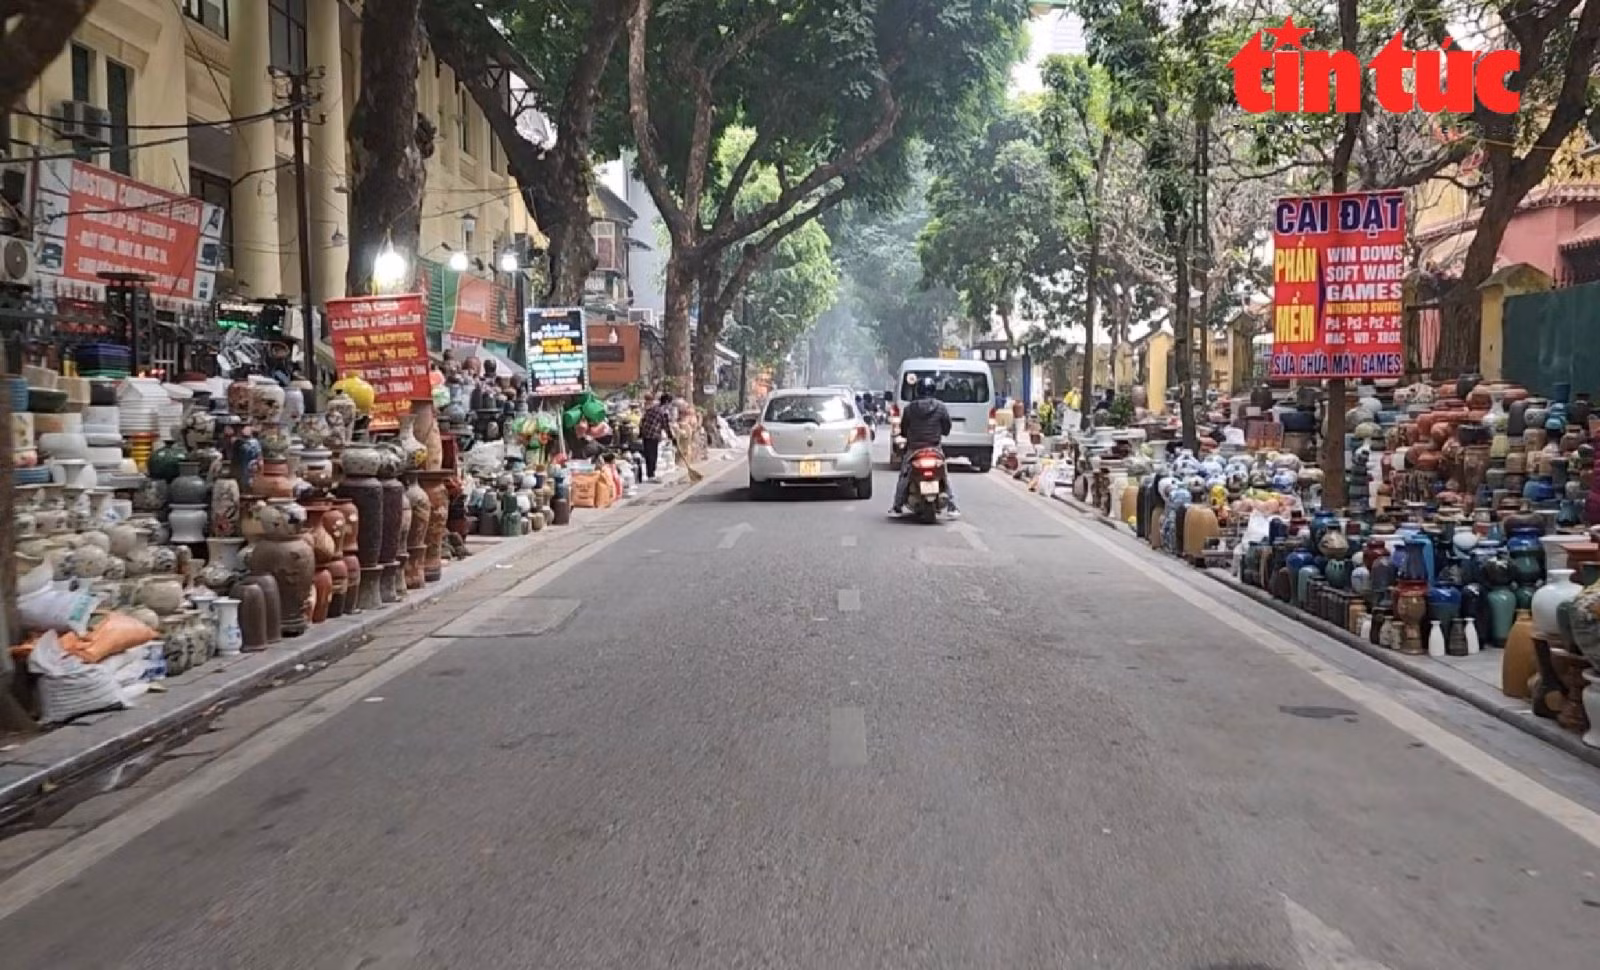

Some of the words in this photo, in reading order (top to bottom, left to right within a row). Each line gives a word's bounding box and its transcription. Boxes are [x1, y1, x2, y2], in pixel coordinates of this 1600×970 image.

[1327, 247, 1356, 263] WIN
[1360, 245, 1402, 261] DOWS
[1326, 266, 1359, 282] SOFT
[1363, 264, 1402, 280] WARE
[1326, 283, 1402, 302] GAMES
[1360, 352, 1402, 375] GAMES
